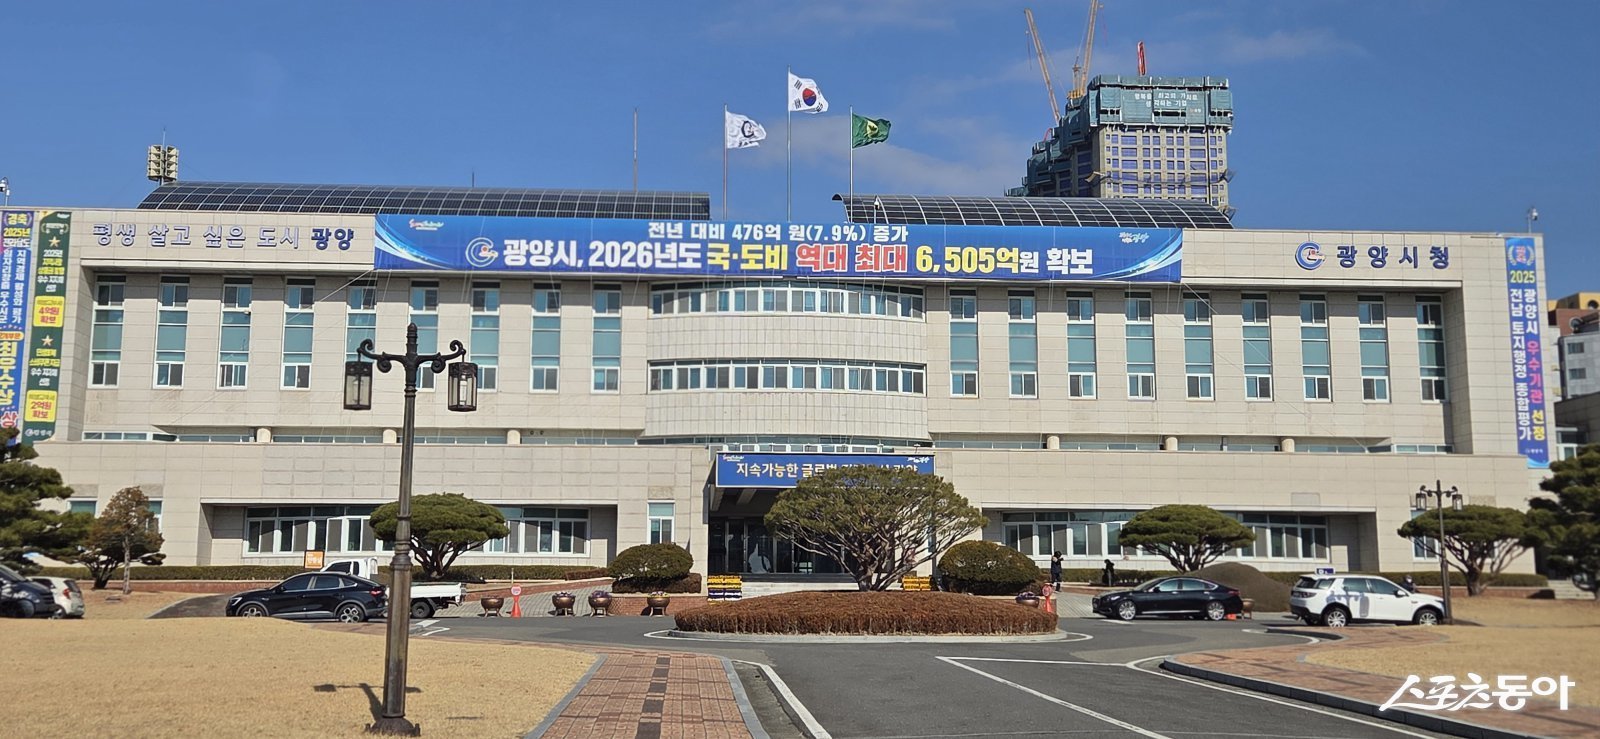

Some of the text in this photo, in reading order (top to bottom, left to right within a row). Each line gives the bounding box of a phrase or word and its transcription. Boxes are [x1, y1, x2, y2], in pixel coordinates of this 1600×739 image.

[8, 214, 27, 225] 경축
[4, 228, 30, 237] 2025년
[92, 223, 136, 246] 평생
[148, 224, 191, 247] 살고
[199, 225, 246, 248] 싶은
[256, 226, 299, 249] 도시
[311, 228, 355, 250] 광양
[648, 222, 908, 242] 전년 대비 476억 원(7.9%) 증가
[3, 238, 30, 247] 전라남도
[503, 239, 584, 268] 광양시,
[588, 241, 702, 270] 2026년도
[707, 243, 788, 270] 국·도비
[796, 243, 848, 272] 역대
[856, 244, 908, 273] 최대
[1046, 248, 1093, 274] 확보
[1337, 246, 1449, 269] 광양시청
[1510, 270, 1536, 283] 2025
[12, 308, 22, 324] 평가
[1510, 289, 1532, 440] 전남 토지행정 종합평가
[1524, 288, 1545, 441] 광양시 우수기관 선정
[0, 341, 17, 405] 최우수상
[31, 401, 52, 410] 2억원
[32, 410, 48, 418] 확보
[736, 462, 798, 478] 지속가능한
